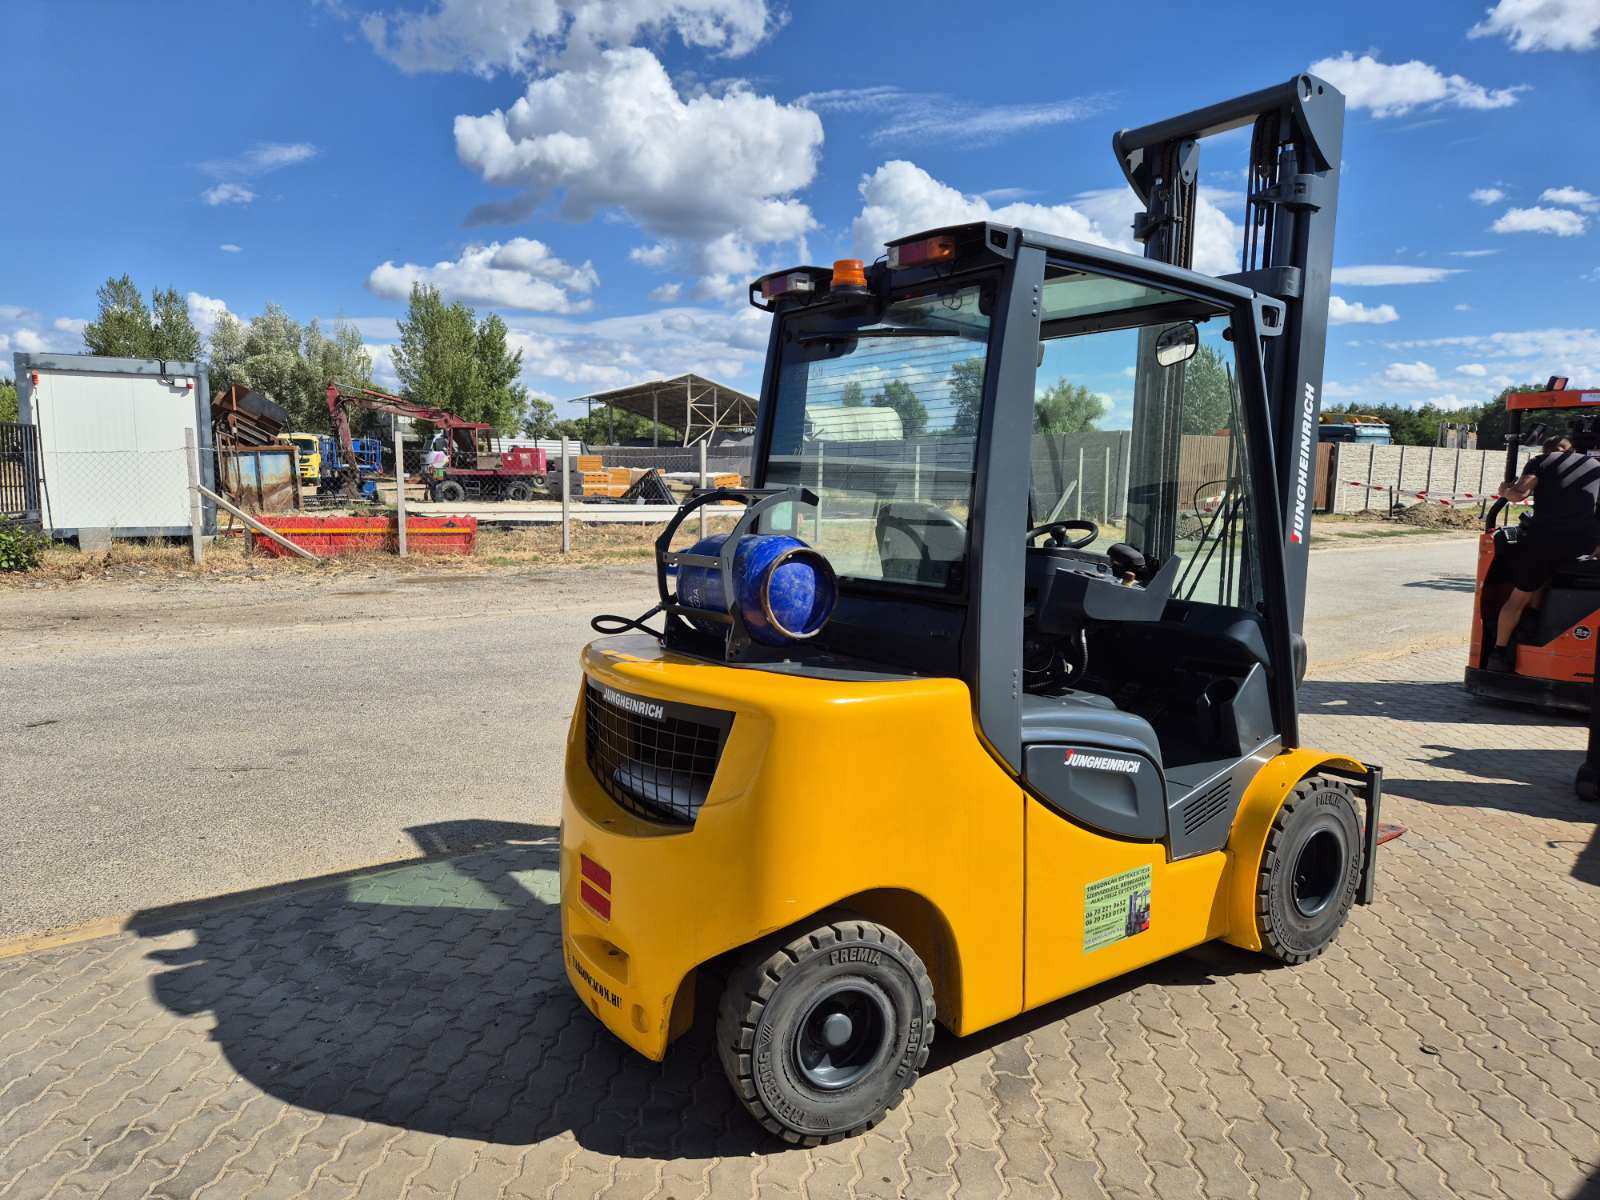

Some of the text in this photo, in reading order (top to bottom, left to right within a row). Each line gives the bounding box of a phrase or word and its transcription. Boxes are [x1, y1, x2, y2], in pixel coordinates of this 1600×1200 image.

[1290, 382, 1315, 545] JUNGHEINRICH
[603, 688, 664, 719] JUNGHEINRICH
[1064, 749, 1140, 773] JUNGHEINRICH
[830, 948, 881, 966] PREMIA
[758, 1051, 807, 1127] TRELLEBORG
